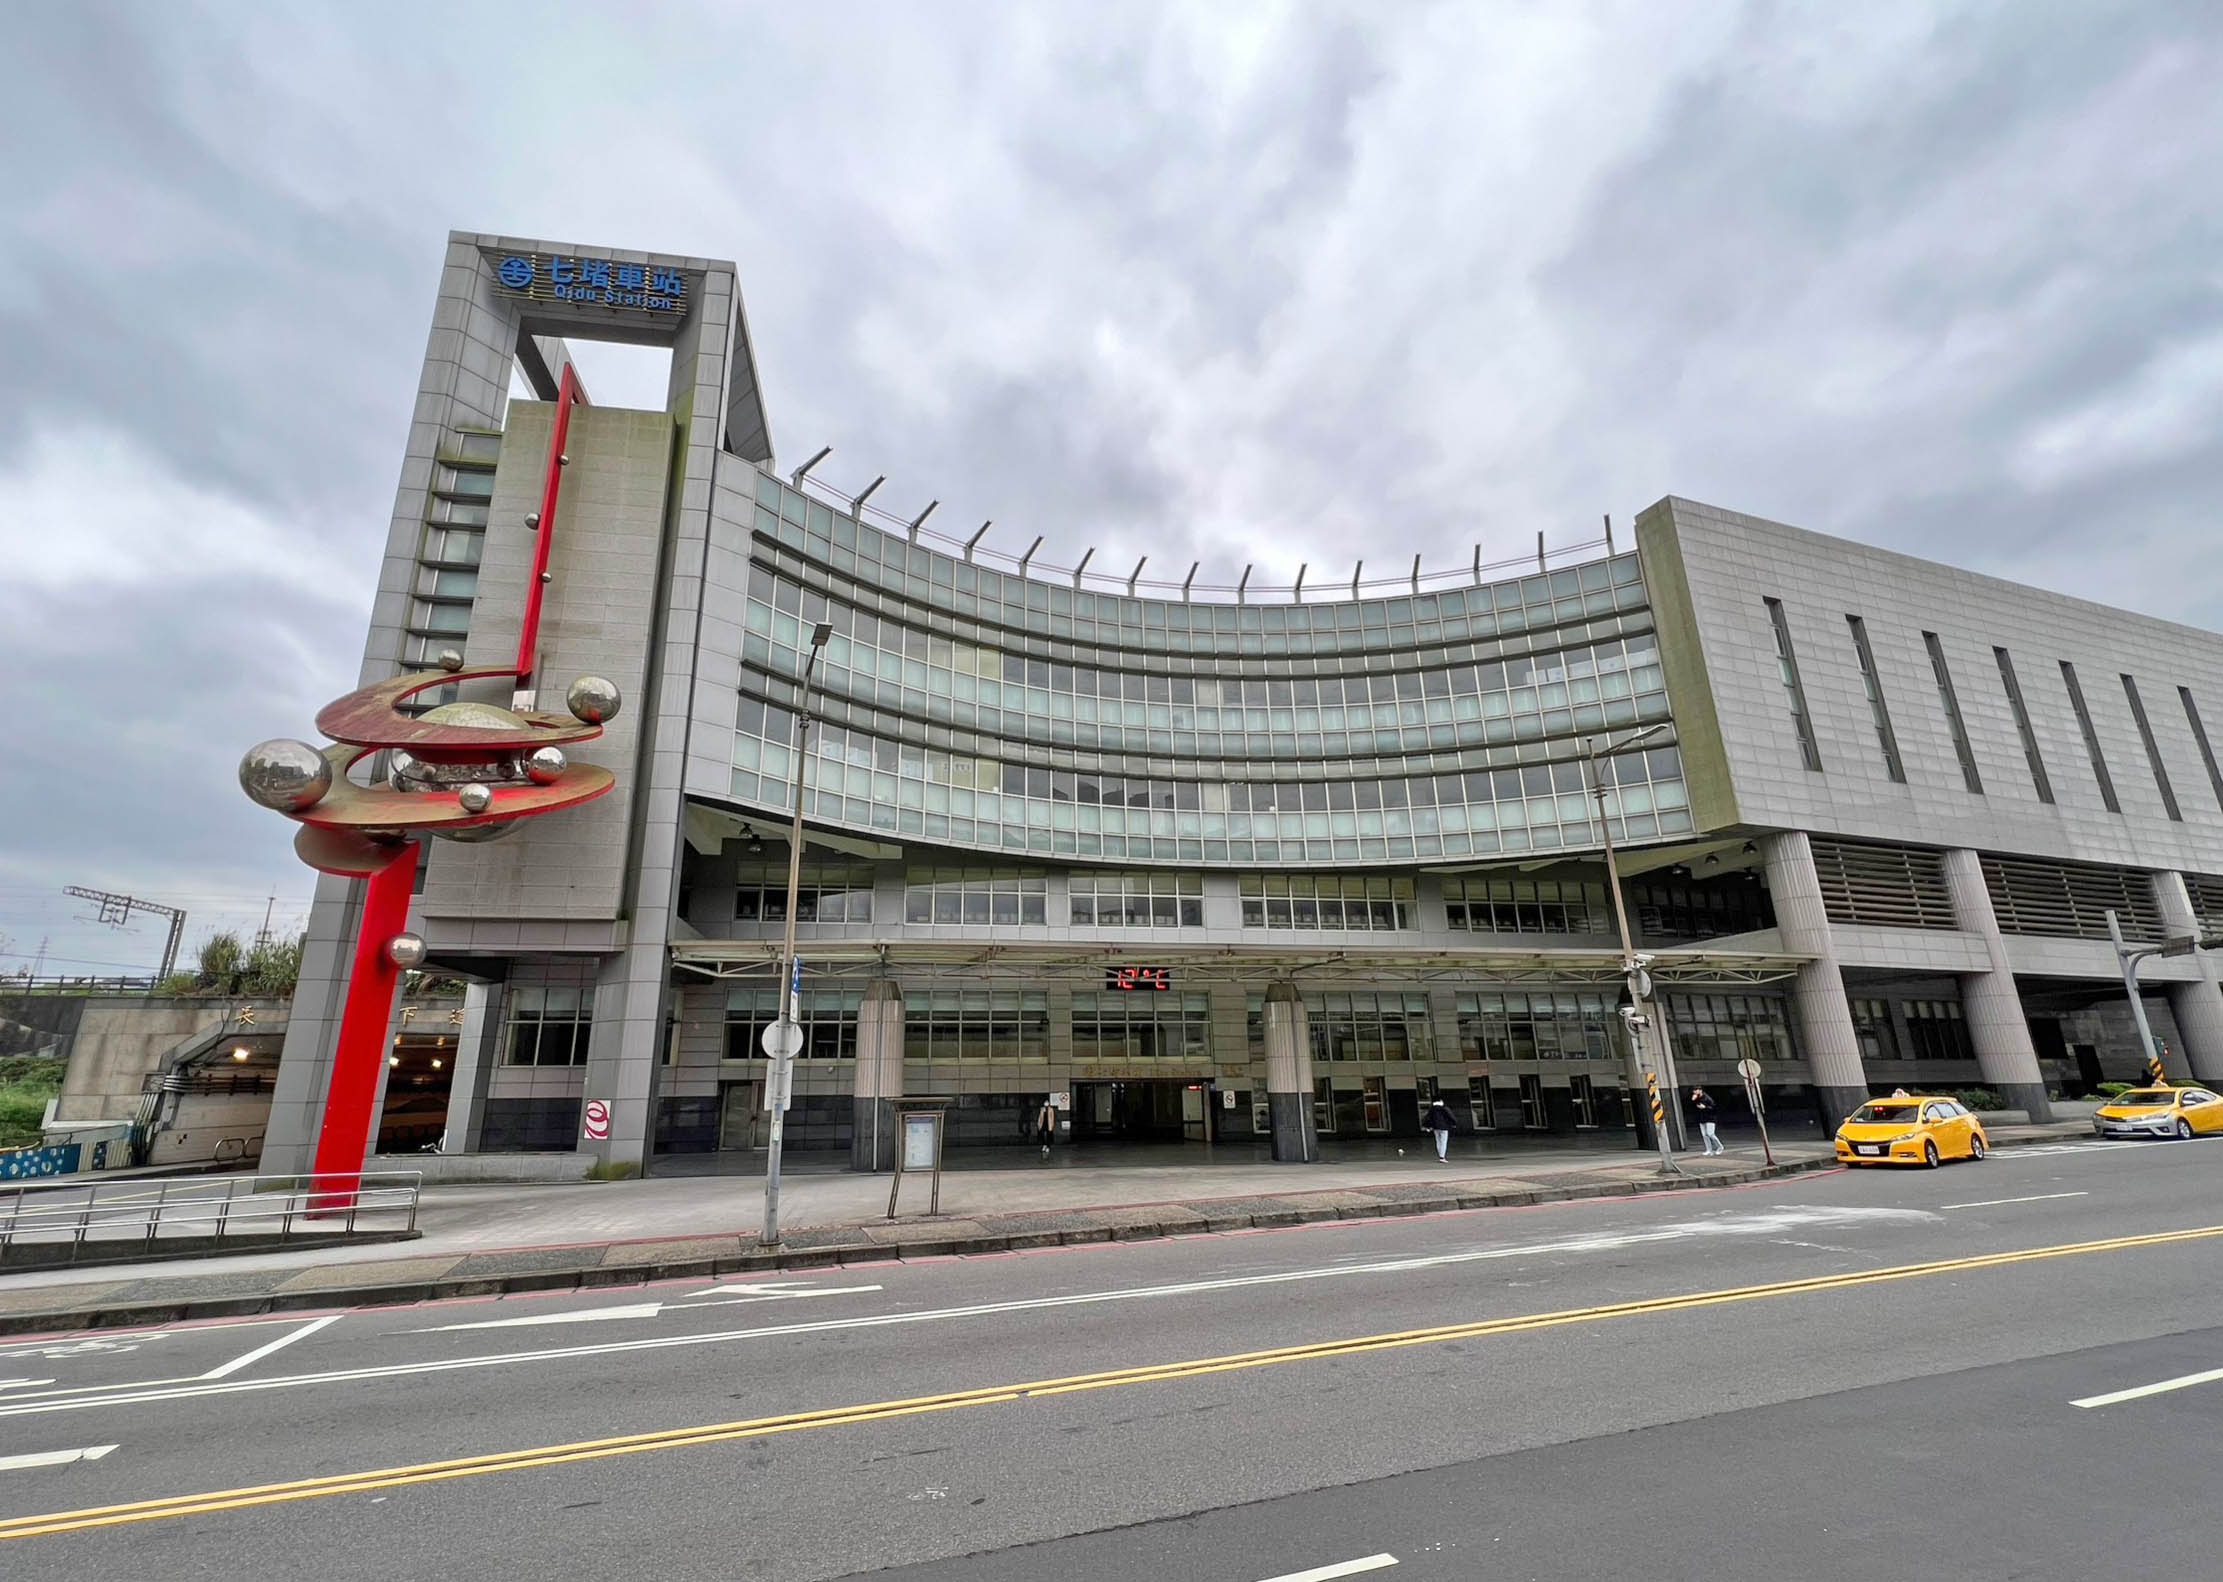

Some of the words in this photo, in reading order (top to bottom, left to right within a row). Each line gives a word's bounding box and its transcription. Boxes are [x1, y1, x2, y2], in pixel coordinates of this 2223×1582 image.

[544, 256, 681, 295] 七堵車站
[554, 284, 596, 300] Qidu
[604, 290, 671, 309] Station
